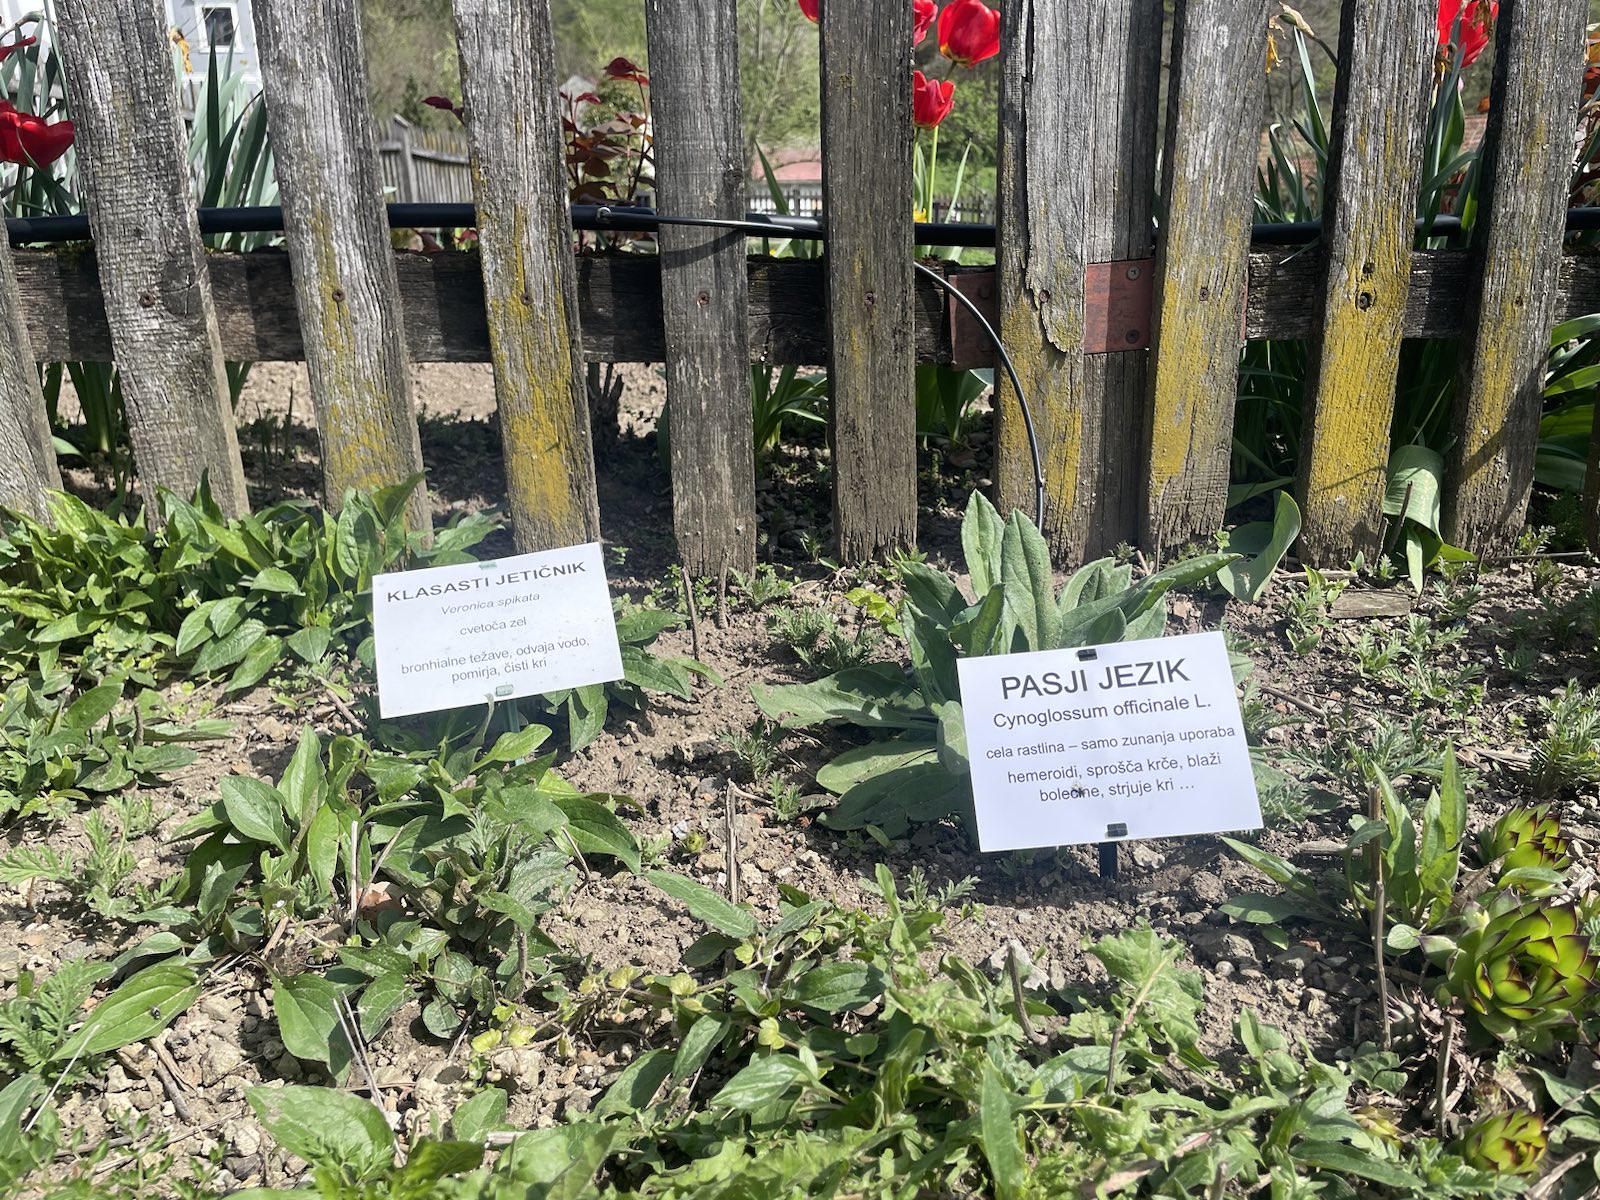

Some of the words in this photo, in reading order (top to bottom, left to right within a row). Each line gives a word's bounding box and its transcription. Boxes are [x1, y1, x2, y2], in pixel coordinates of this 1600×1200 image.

[387, 577, 490, 602] KLASASTI
[495, 561, 586, 586] JETIČNIK
[441, 600, 494, 615] Veronica
[498, 592, 540, 607] spikata
[460, 620, 506, 636] cvetoča
[510, 617, 526, 628] zel
[401, 656, 466, 675] bronhialne
[469, 650, 512, 665] težave,
[516, 643, 555, 657] odvaja
[558, 636, 589, 649] vodo,
[452, 668, 500, 684] pomirja,
[504, 660, 529, 674] čisti
[532, 658, 547, 669] kri
[1000, 670, 1088, 700] PASJI
[1098, 658, 1190, 690] JEZIK
[993, 706, 1108, 730] Cynoglossum
[1114, 696, 1190, 716] officinale
[1194, 694, 1212, 708] L.
[986, 744, 1013, 760] cela
[1017, 740, 1065, 757] rastlina
[1081, 737, 1118, 751] samo
[1122, 731, 1174, 747] zunanja
[1179, 725, 1236, 744] uporaba
[1008, 766, 1082, 784] hemeroidi,
[1086, 760, 1143, 781] sprošča
[1147, 756, 1184, 772] krče,
[1186, 752, 1222, 768] blaži
[1040, 786, 1104, 802] bolene,
[1108, 780, 1152, 798] strjuje
[1156, 778, 1174, 792] kri
